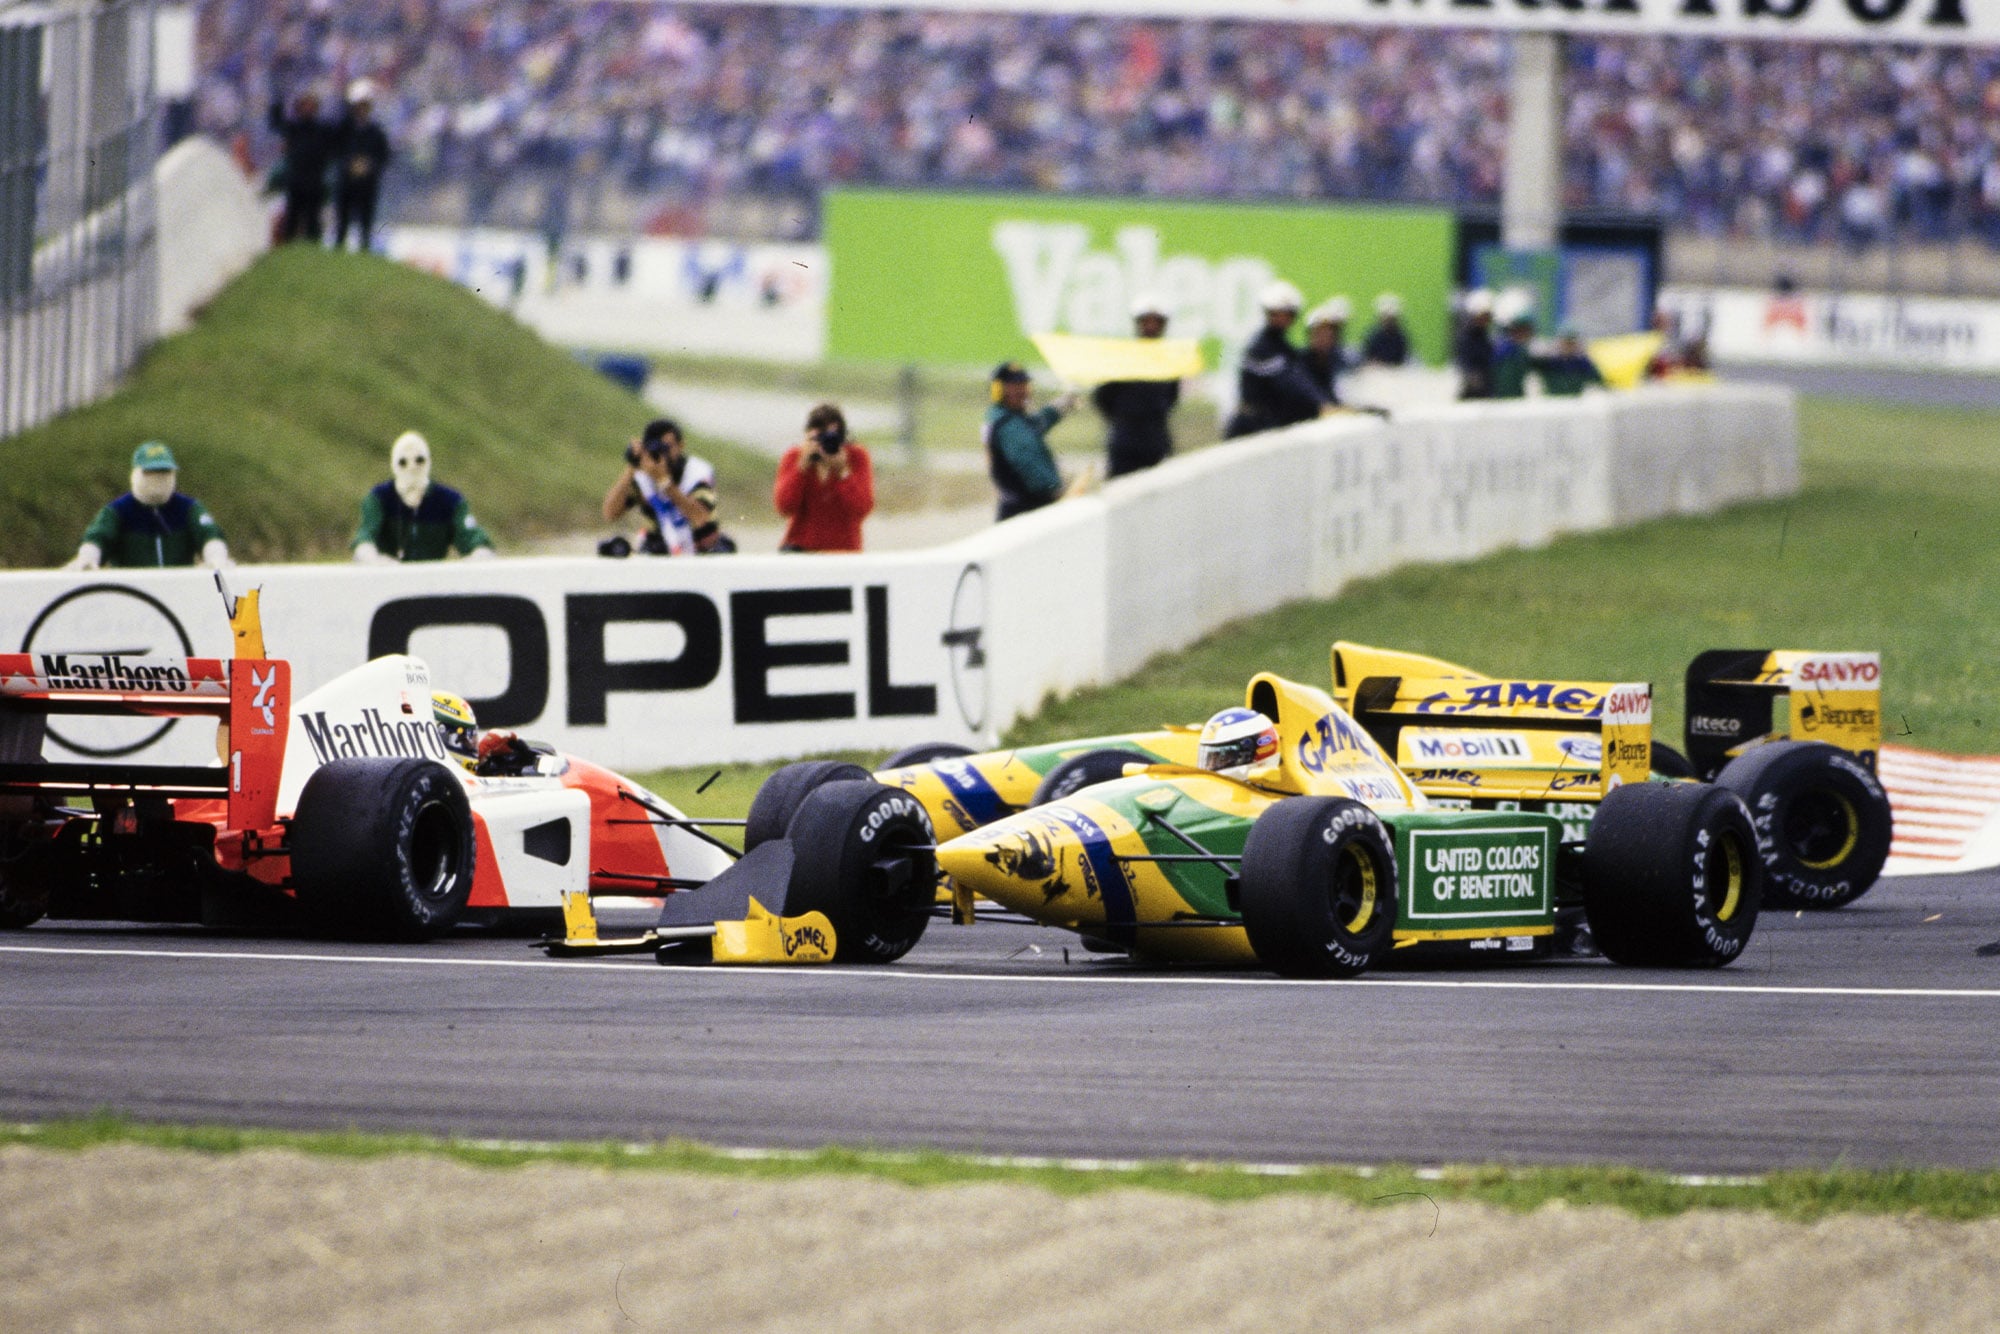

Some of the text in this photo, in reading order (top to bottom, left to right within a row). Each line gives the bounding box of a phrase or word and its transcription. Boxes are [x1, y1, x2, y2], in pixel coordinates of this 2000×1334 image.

[367, 584, 937, 727] OPEL
[41, 654, 187, 692] Marlboro
[1800, 662, 1879, 681] SANYO
[1609, 692, 1649, 715] SANYO
[298, 708, 446, 766] Marlboro
[1418, 738, 1495, 757] Mobil
[231, 750, 242, 792] 1
[1551, 773, 1602, 791] CAM
[1425, 846, 1539, 872] UNITED COLORS
[1433, 876, 1456, 900] OF
[785, 926, 829, 957] CAMEL
[1326, 939, 1370, 968] EAGLE
